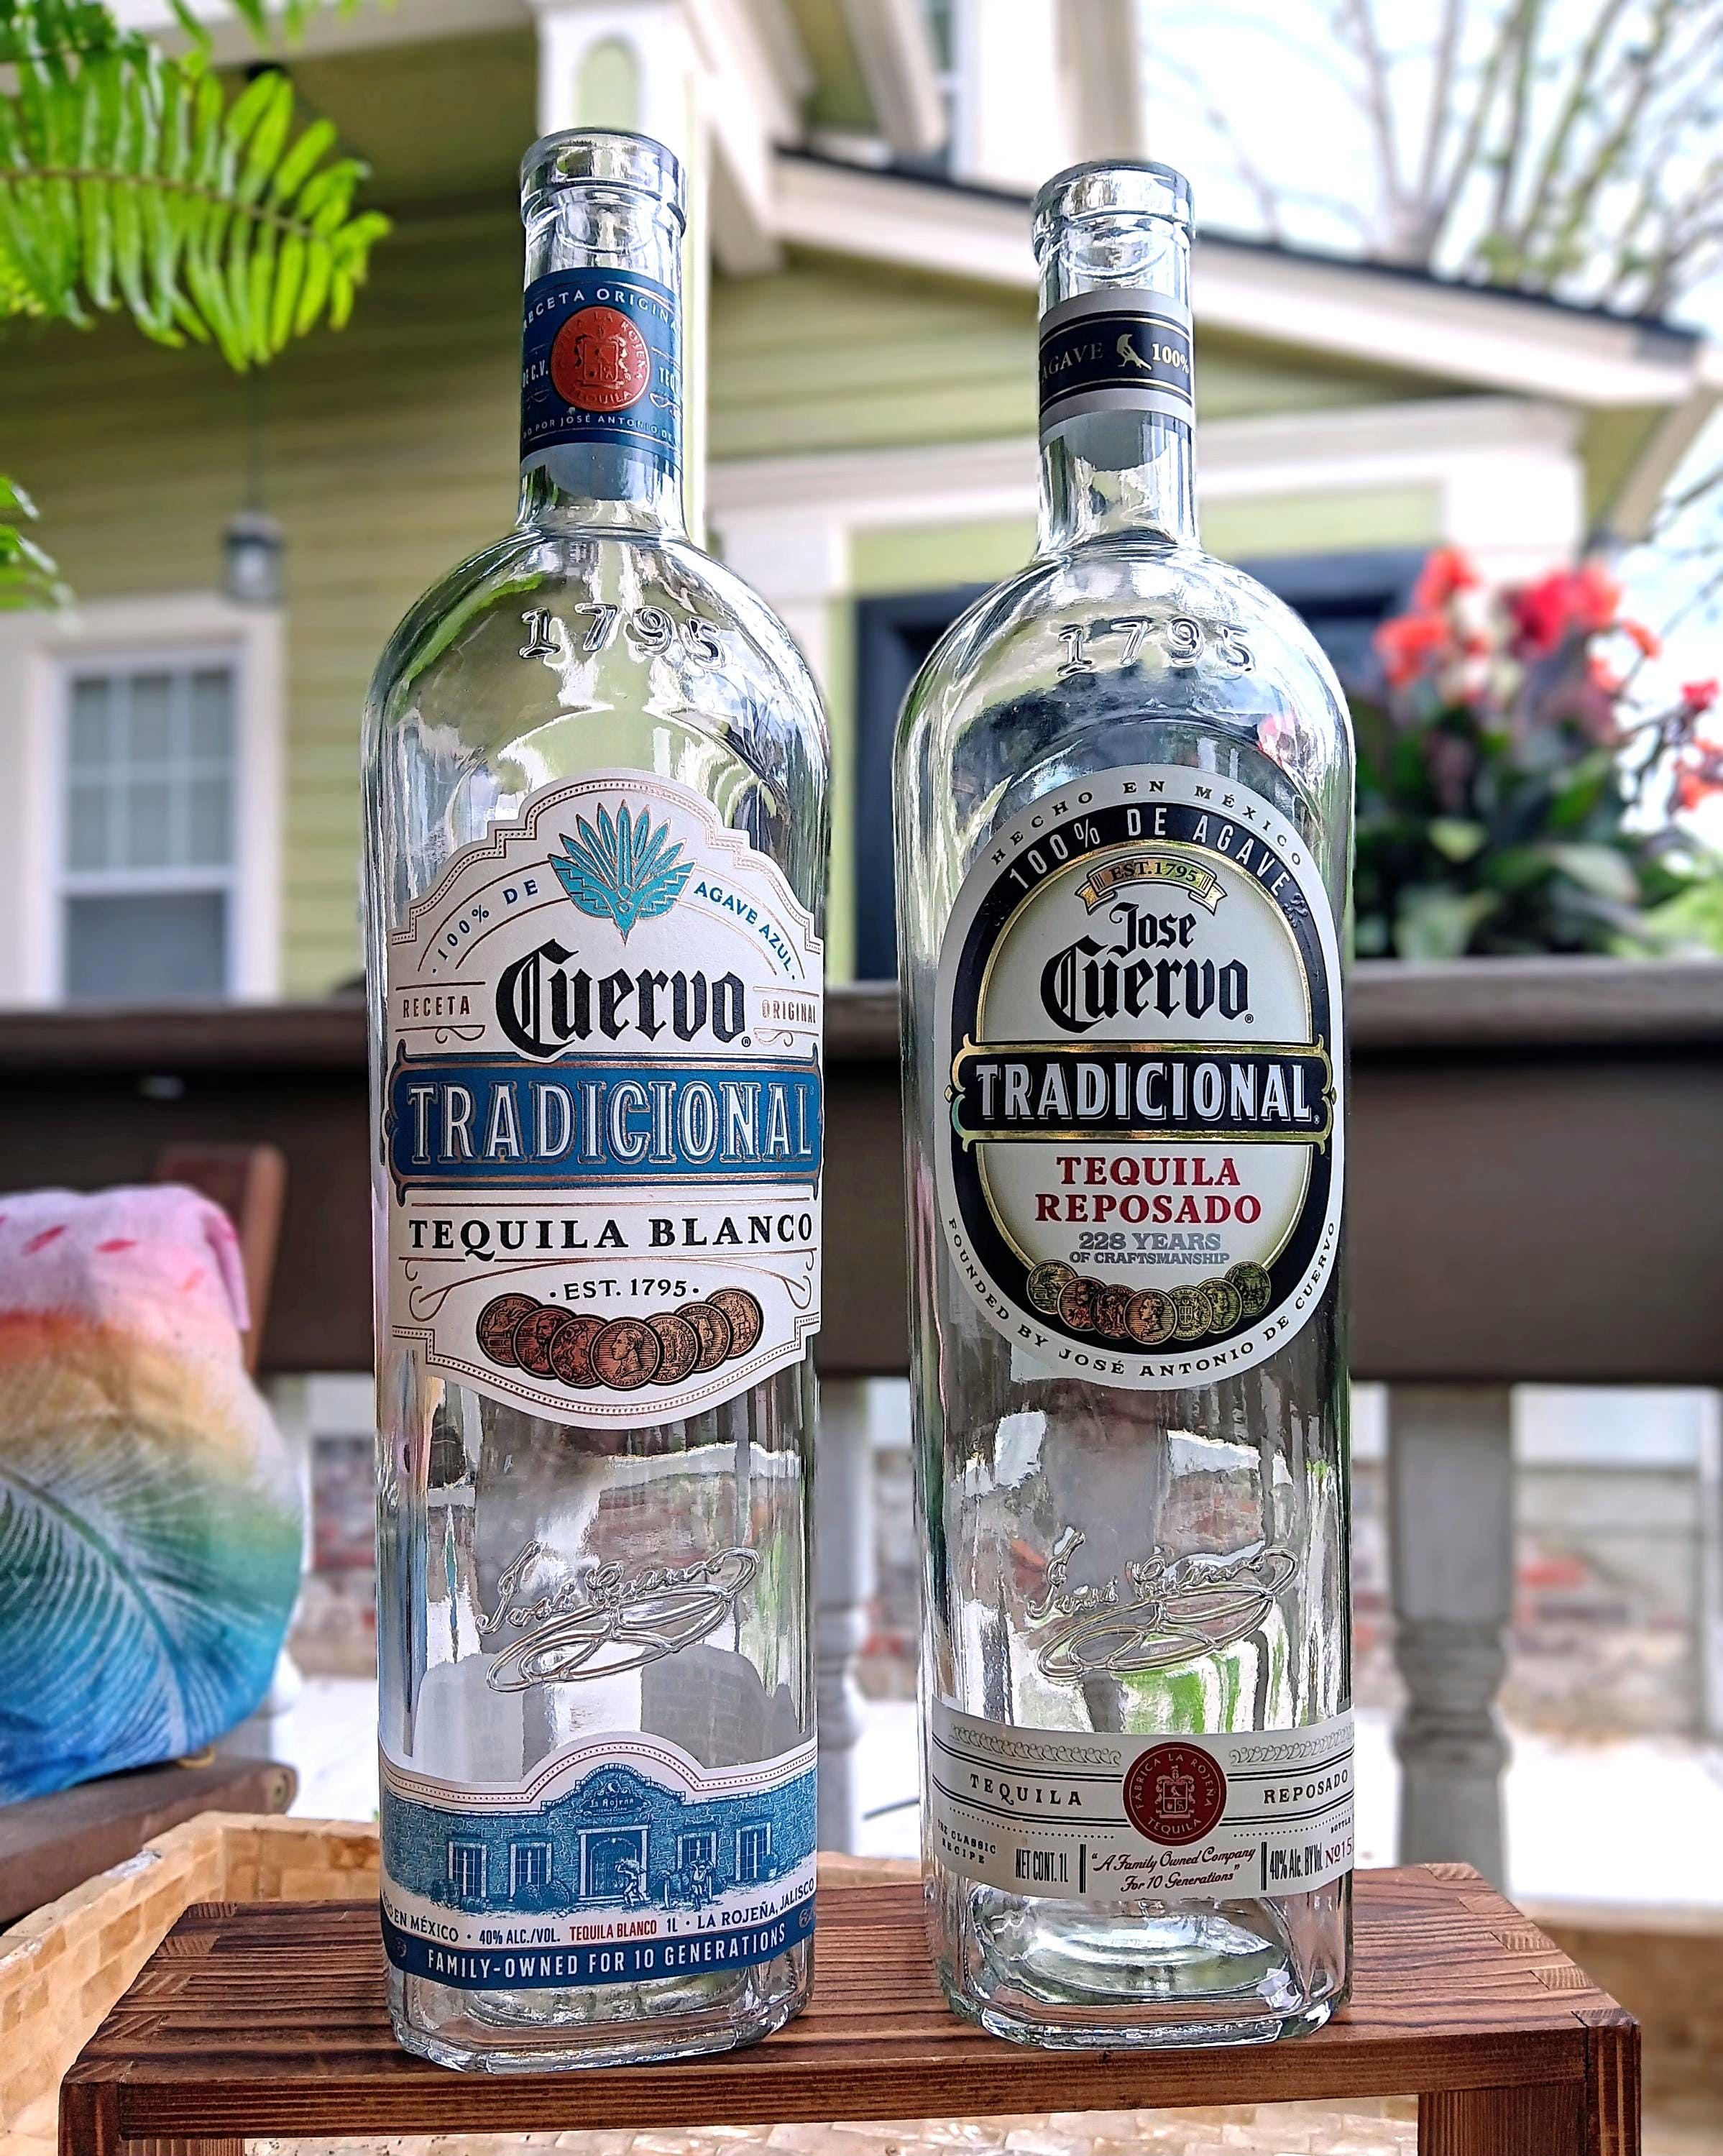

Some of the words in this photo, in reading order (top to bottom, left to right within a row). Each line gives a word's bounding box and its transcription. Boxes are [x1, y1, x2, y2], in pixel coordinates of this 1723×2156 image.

[532, 359, 548, 380] C.V.
[1042, 342, 1103, 383] AGAVE
[1152, 343, 1190, 374] 100%
[536, 419, 555, 431] POR
[561, 413, 590, 427] JOSÉ
[597, 415, 657, 434] ANTONIO
[661, 428, 674, 441] DE
[518, 602, 725, 670] 1795
[1057, 615, 1256, 677] 1795
[991, 792, 1093, 866] HECHO
[1123, 781, 1164, 794] EN
[1194, 786, 1300, 866] MÉXICO
[1009, 819, 1101, 889] 100%
[1126, 808, 1167, 837] DE
[1192, 815, 1290, 896] AGAVE
[438, 904, 490, 960] 100%
[502, 879, 538, 904] DE
[693, 881, 758, 925] AGAVE
[758, 924, 796, 972] AZUL
[1106, 902, 1197, 958] Jose
[495, 938, 745, 1058] Cuervo
[1040, 935, 1249, 1034] Cuervo
[403, 996, 470, 1018] RECETA
[762, 999, 816, 1024] ORIGINAL
[975, 1063, 1312, 1122] TRADICIONAL
[408, 1080, 813, 1164] TRADICIONAL
[1056, 1156, 1241, 1186] TEQUILA
[1035, 1193, 1262, 1224] REPOSADO
[409, 1218, 628, 1261] TEQUILA
[648, 1212, 813, 1248] BLANCO
[1079, 1232, 1126, 1250] 228
[1131, 1232, 1221, 1251] YEARS
[1069, 1251, 1090, 1264] OF
[1094, 1251, 1231, 1265] CRAFTSMANSHIP
[564, 1280, 621, 1301] EST.
[630, 1279, 687, 1297] 1795
[948, 1217, 1009, 1321] FOUNDED
[1017, 1324, 1049, 1347] BY
[1058, 1348, 1124, 1375] JOSÉ
[1139, 1342, 1254, 1377] ANTONIO
[1262, 1316, 1290, 1341] DE
[1295, 1222, 1334, 1311] CUERVO
[970, 1774, 1083, 1806] TEQUILA
[1168, 1753, 1184, 1762] LA
[1190, 1758, 1216, 1807] ROJEÑA
[1264, 1769, 1348, 1804] REPOSADO
[951, 1830, 996, 1854] CLASSIC
[1147, 1817, 1202, 1835] TEQUILA
[942, 1838, 985, 1865] RECIPE
[1016, 1848, 1031, 1880] NET
[1033, 1850, 1057, 1882] CONT.
[1059, 1853, 1069, 1882] 1L
[1113, 1854, 1157, 1873] Family
[1159, 1850, 1201, 1867] Owned
[1201, 1846, 1256, 1866] Company
[1269, 1849, 1287, 1880] 40%
[1289, 1848, 1303, 1879] Alc.
[1121, 1875, 1144, 1893] For
[1147, 1875, 1163, 1889] 10
[394, 1908, 407, 1927] EN
[410, 1915, 459, 1942] MÉXICO
[479, 1930, 502, 1945] 40%
[506, 1927, 561, 1944] ALC./VOL.
[569, 1923, 614, 1941] TEQUILA
[617, 1919, 657, 1938] BLANCO
[666, 1917, 678, 1933] 1L
[697, 1915, 716, 1930] LA
[722, 1901, 779, 1927] ROJEÑA,
[780, 1877, 814, 1912] JALISCO
[428, 1949, 578, 1978] FAMILY-OWNED
[589, 1953, 625, 1973] FOR
[635, 1948, 654, 1969] 10
[664, 1922, 786, 1966] GENERATIONS
